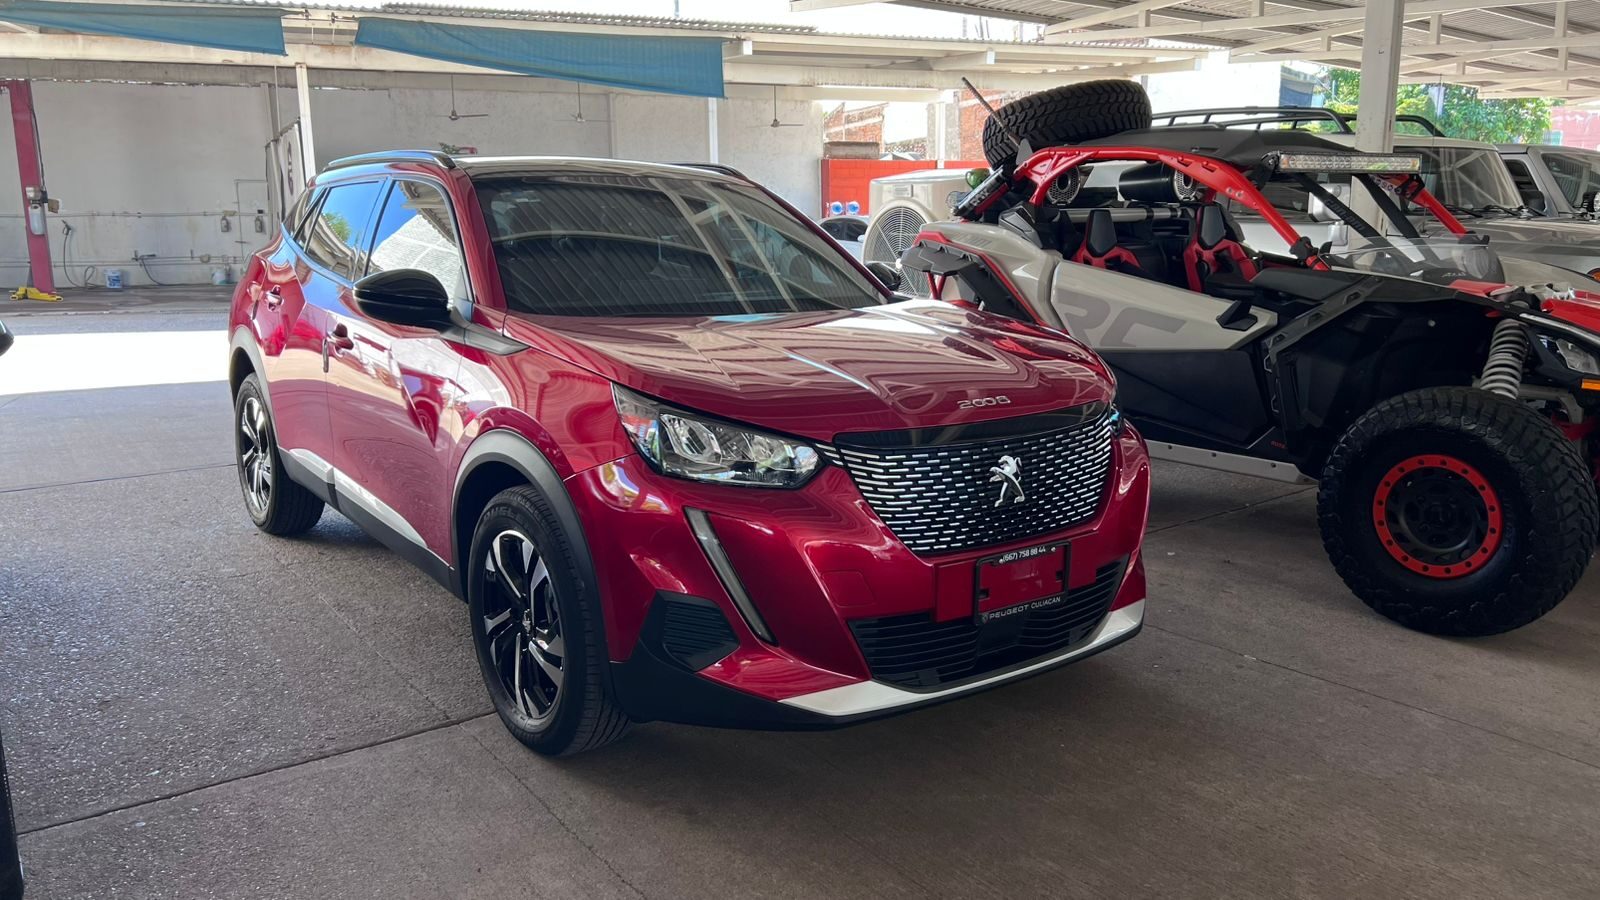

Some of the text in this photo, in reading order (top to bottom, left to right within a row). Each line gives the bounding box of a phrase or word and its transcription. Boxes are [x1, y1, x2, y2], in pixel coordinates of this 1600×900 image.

[957, 395, 1011, 409] 2008
[1002, 551, 1018, 562] (667)
[1018, 549, 1030, 558] 758
[1030, 547, 1038, 555] 88
[989, 596, 1061, 620] PEUGEOT CULIACAN
